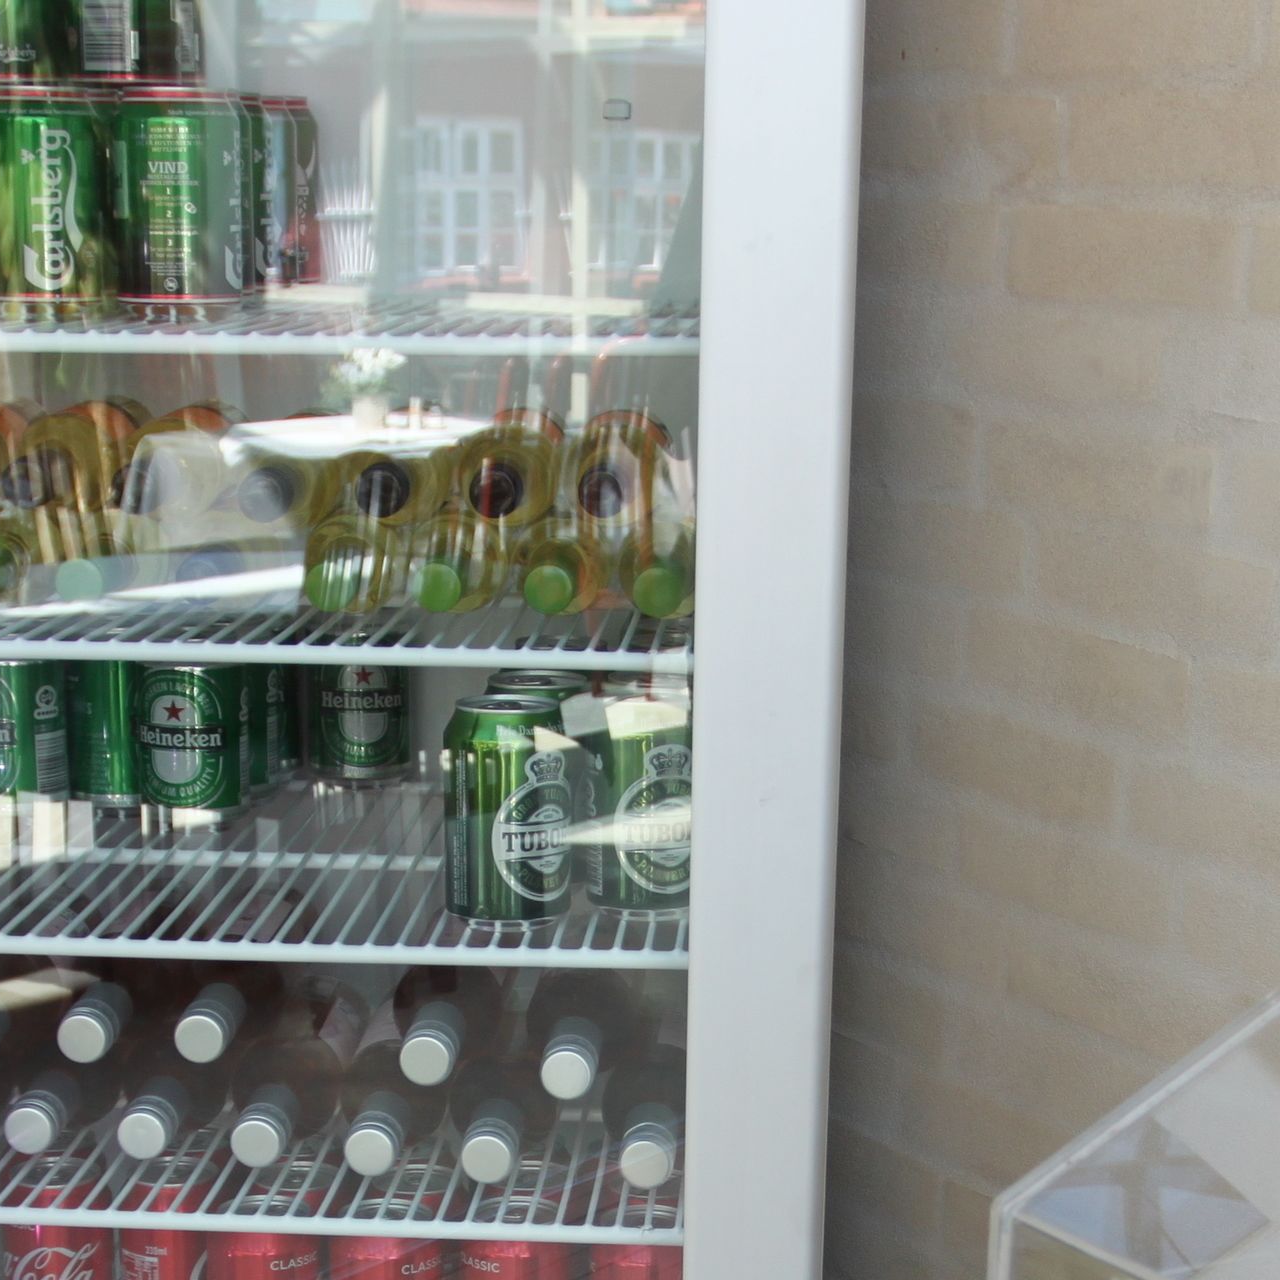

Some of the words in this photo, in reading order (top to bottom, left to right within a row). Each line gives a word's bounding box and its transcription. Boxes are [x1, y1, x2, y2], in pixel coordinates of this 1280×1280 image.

[147, 161, 189, 174] VIND
[23, 128, 83, 291] Carlsberg
[321, 691, 403, 709] Heineken
[140, 725, 222, 748] Heineken
[178, 767, 215, 798] QUALITY
[502, 827, 567, 853] TUBO
[626, 821, 689, 846] TUBO
[401, 1255, 441, 1275] CLASS
[460, 1250, 500, 1273] LASSIC
